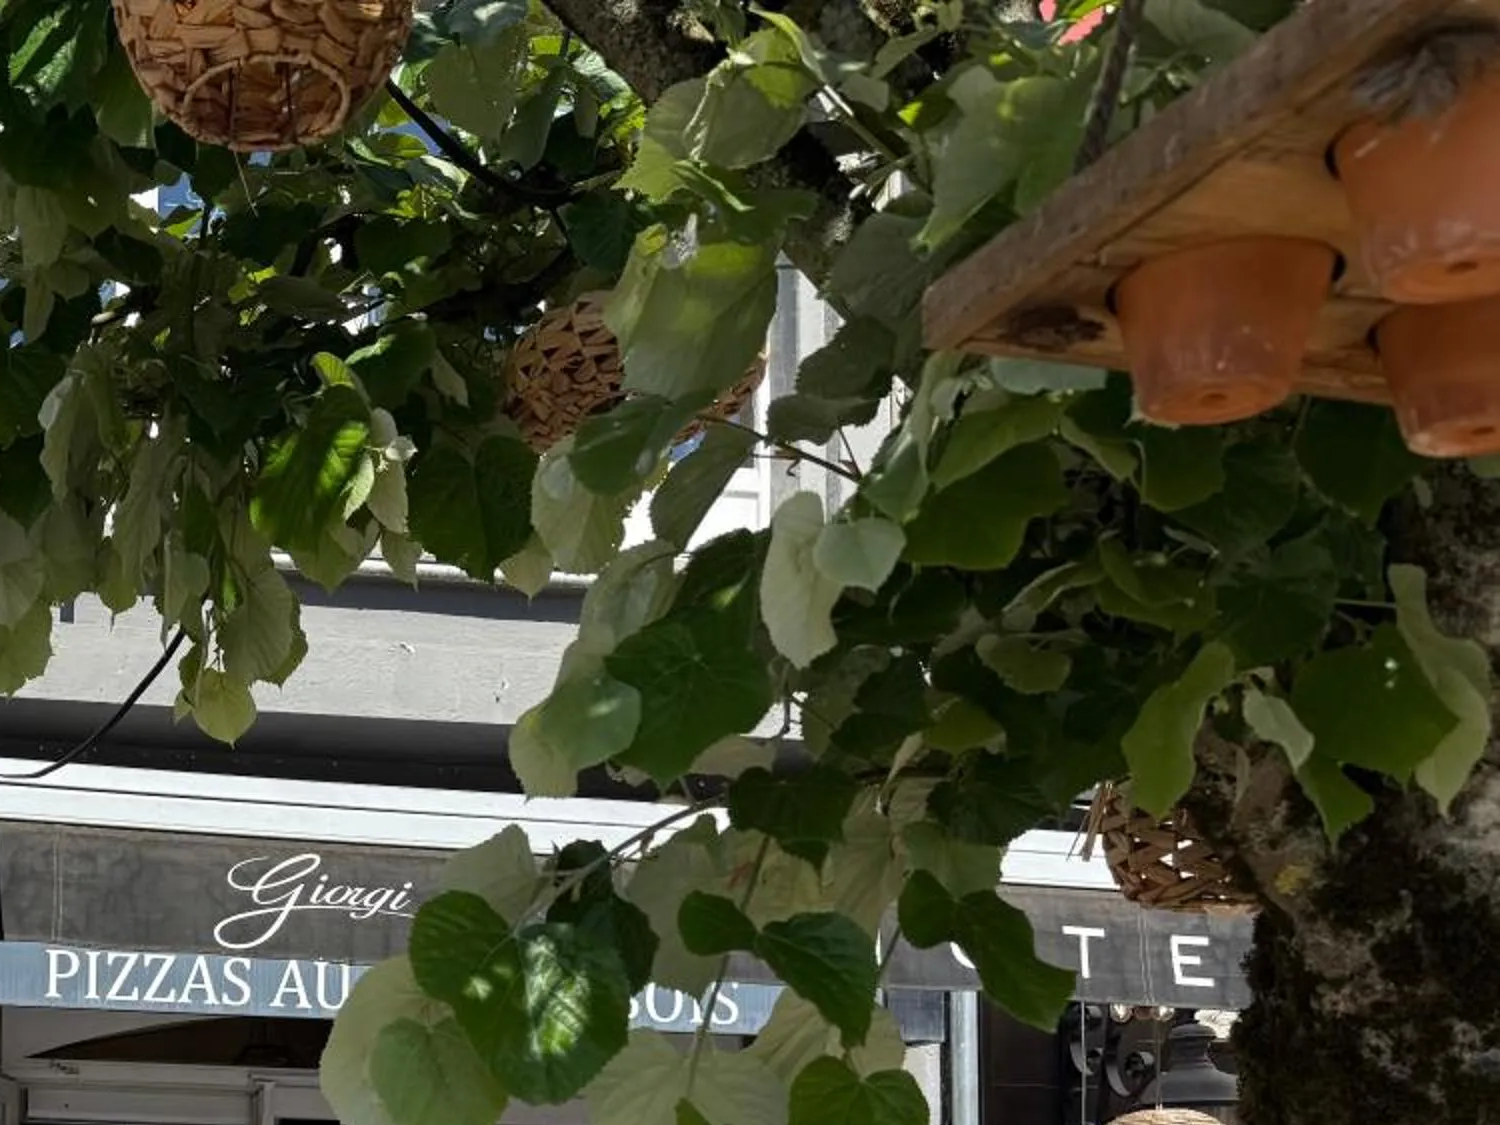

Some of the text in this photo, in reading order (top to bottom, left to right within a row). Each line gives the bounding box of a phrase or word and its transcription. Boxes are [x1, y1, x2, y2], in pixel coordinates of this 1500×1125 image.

[213, 853, 415, 949] Giorgi
[44, 949, 740, 1025] PIZZAS AU OIS
